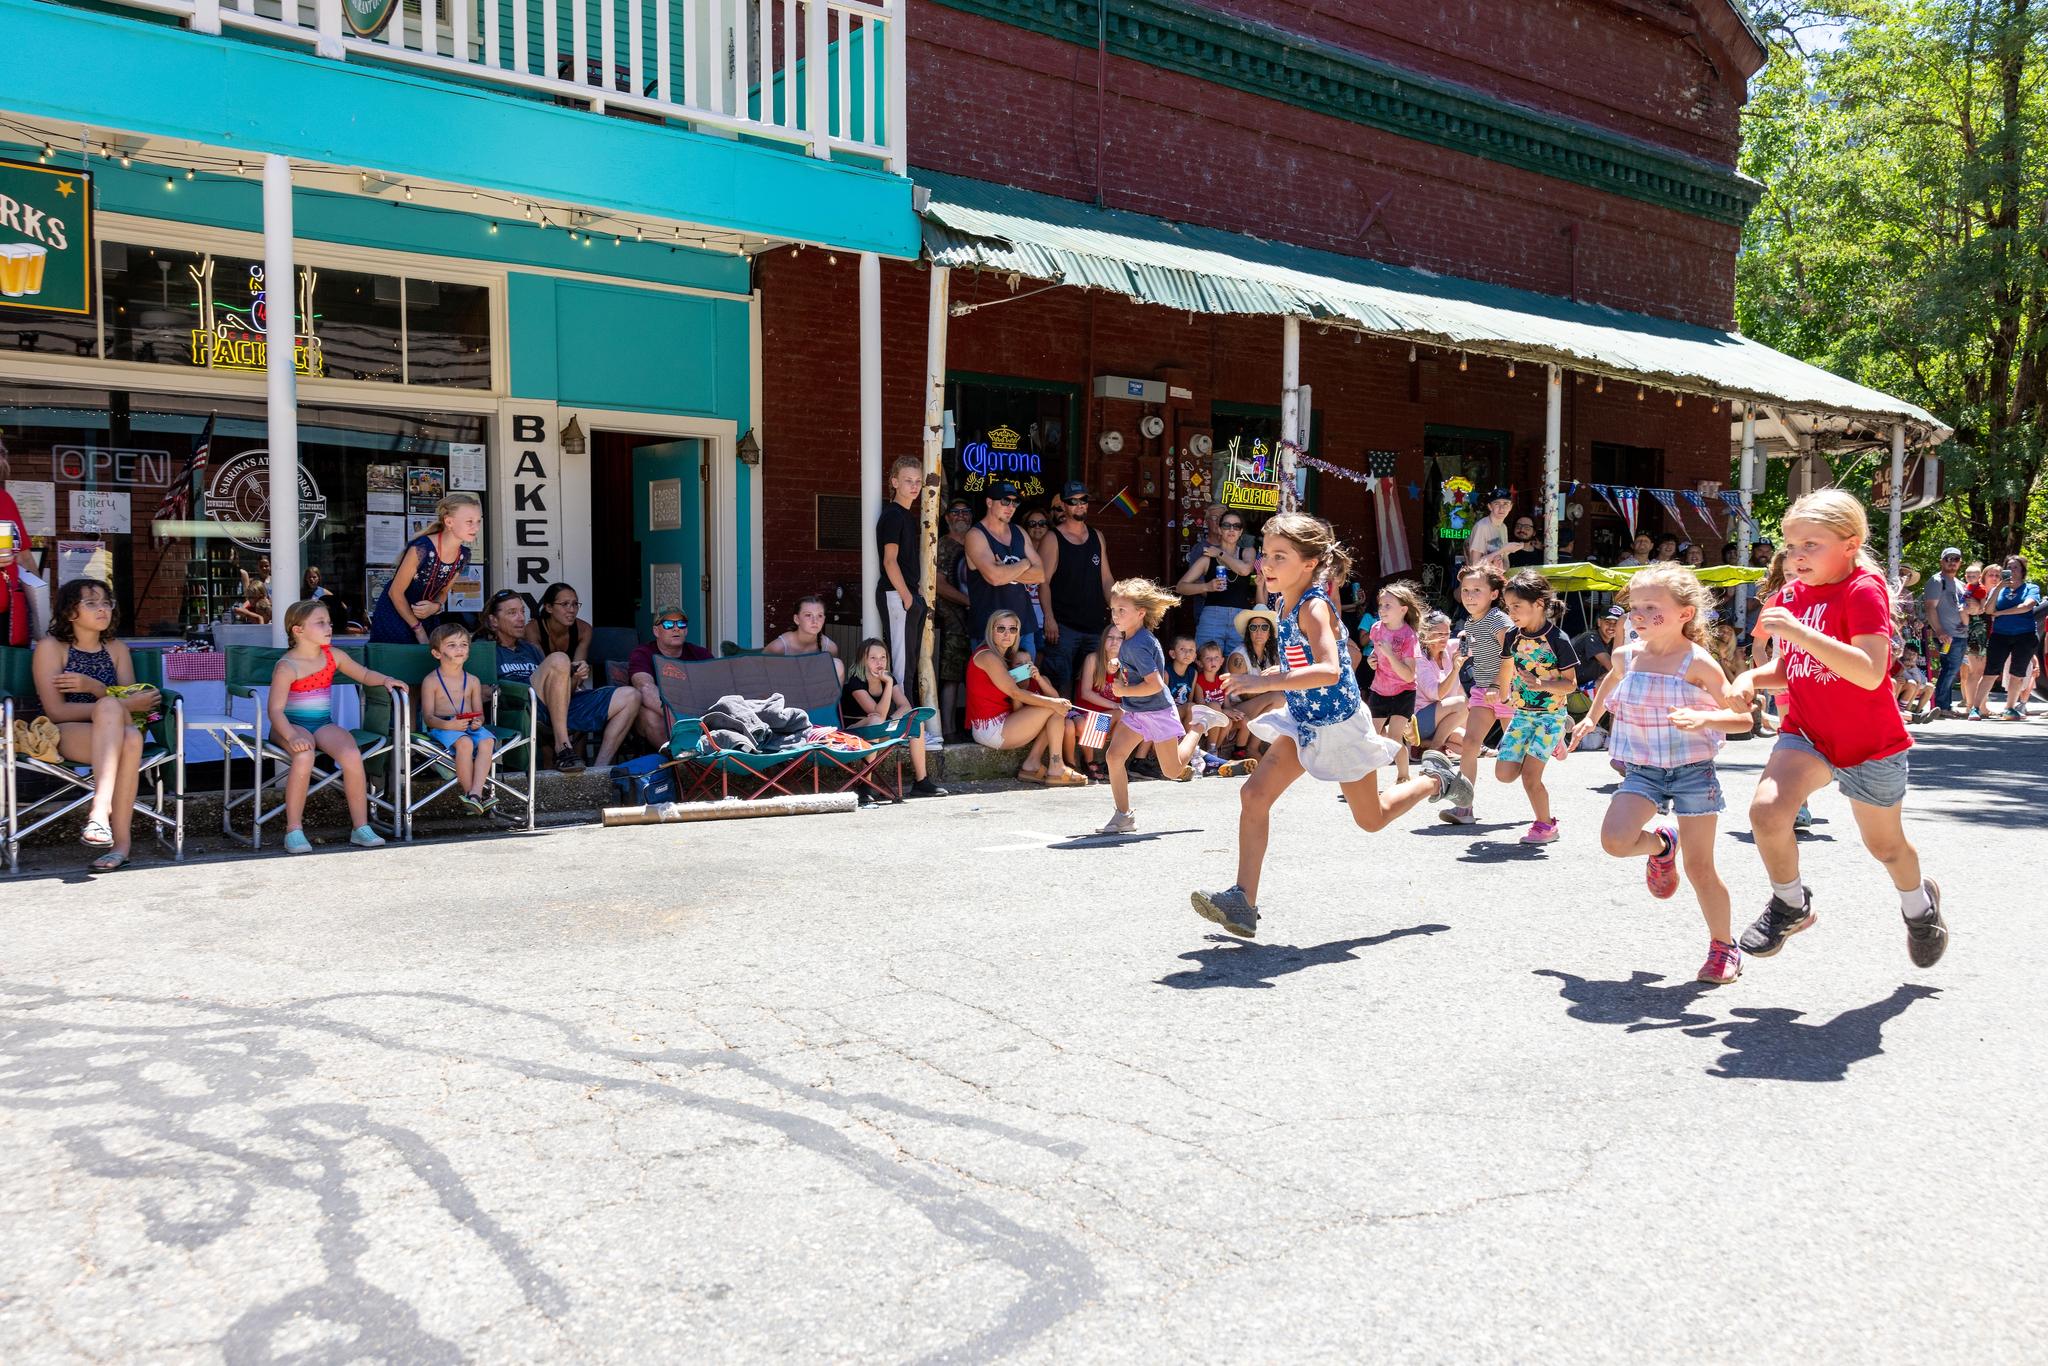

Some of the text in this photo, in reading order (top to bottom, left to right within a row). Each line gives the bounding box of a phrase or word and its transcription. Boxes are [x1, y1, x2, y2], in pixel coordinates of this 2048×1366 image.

[61, 450, 164, 482] OPEN
[963, 443, 1041, 477] Corona
[219, 458, 256, 494] SABRINA'S
[297, 471, 312, 498] ORKS
[1222, 481, 1279, 506] PACIFICO
[513, 415, 550, 619] BAKERY
[1440, 528, 1461, 538] PALE
[1786, 653, 1811, 684] Girl
